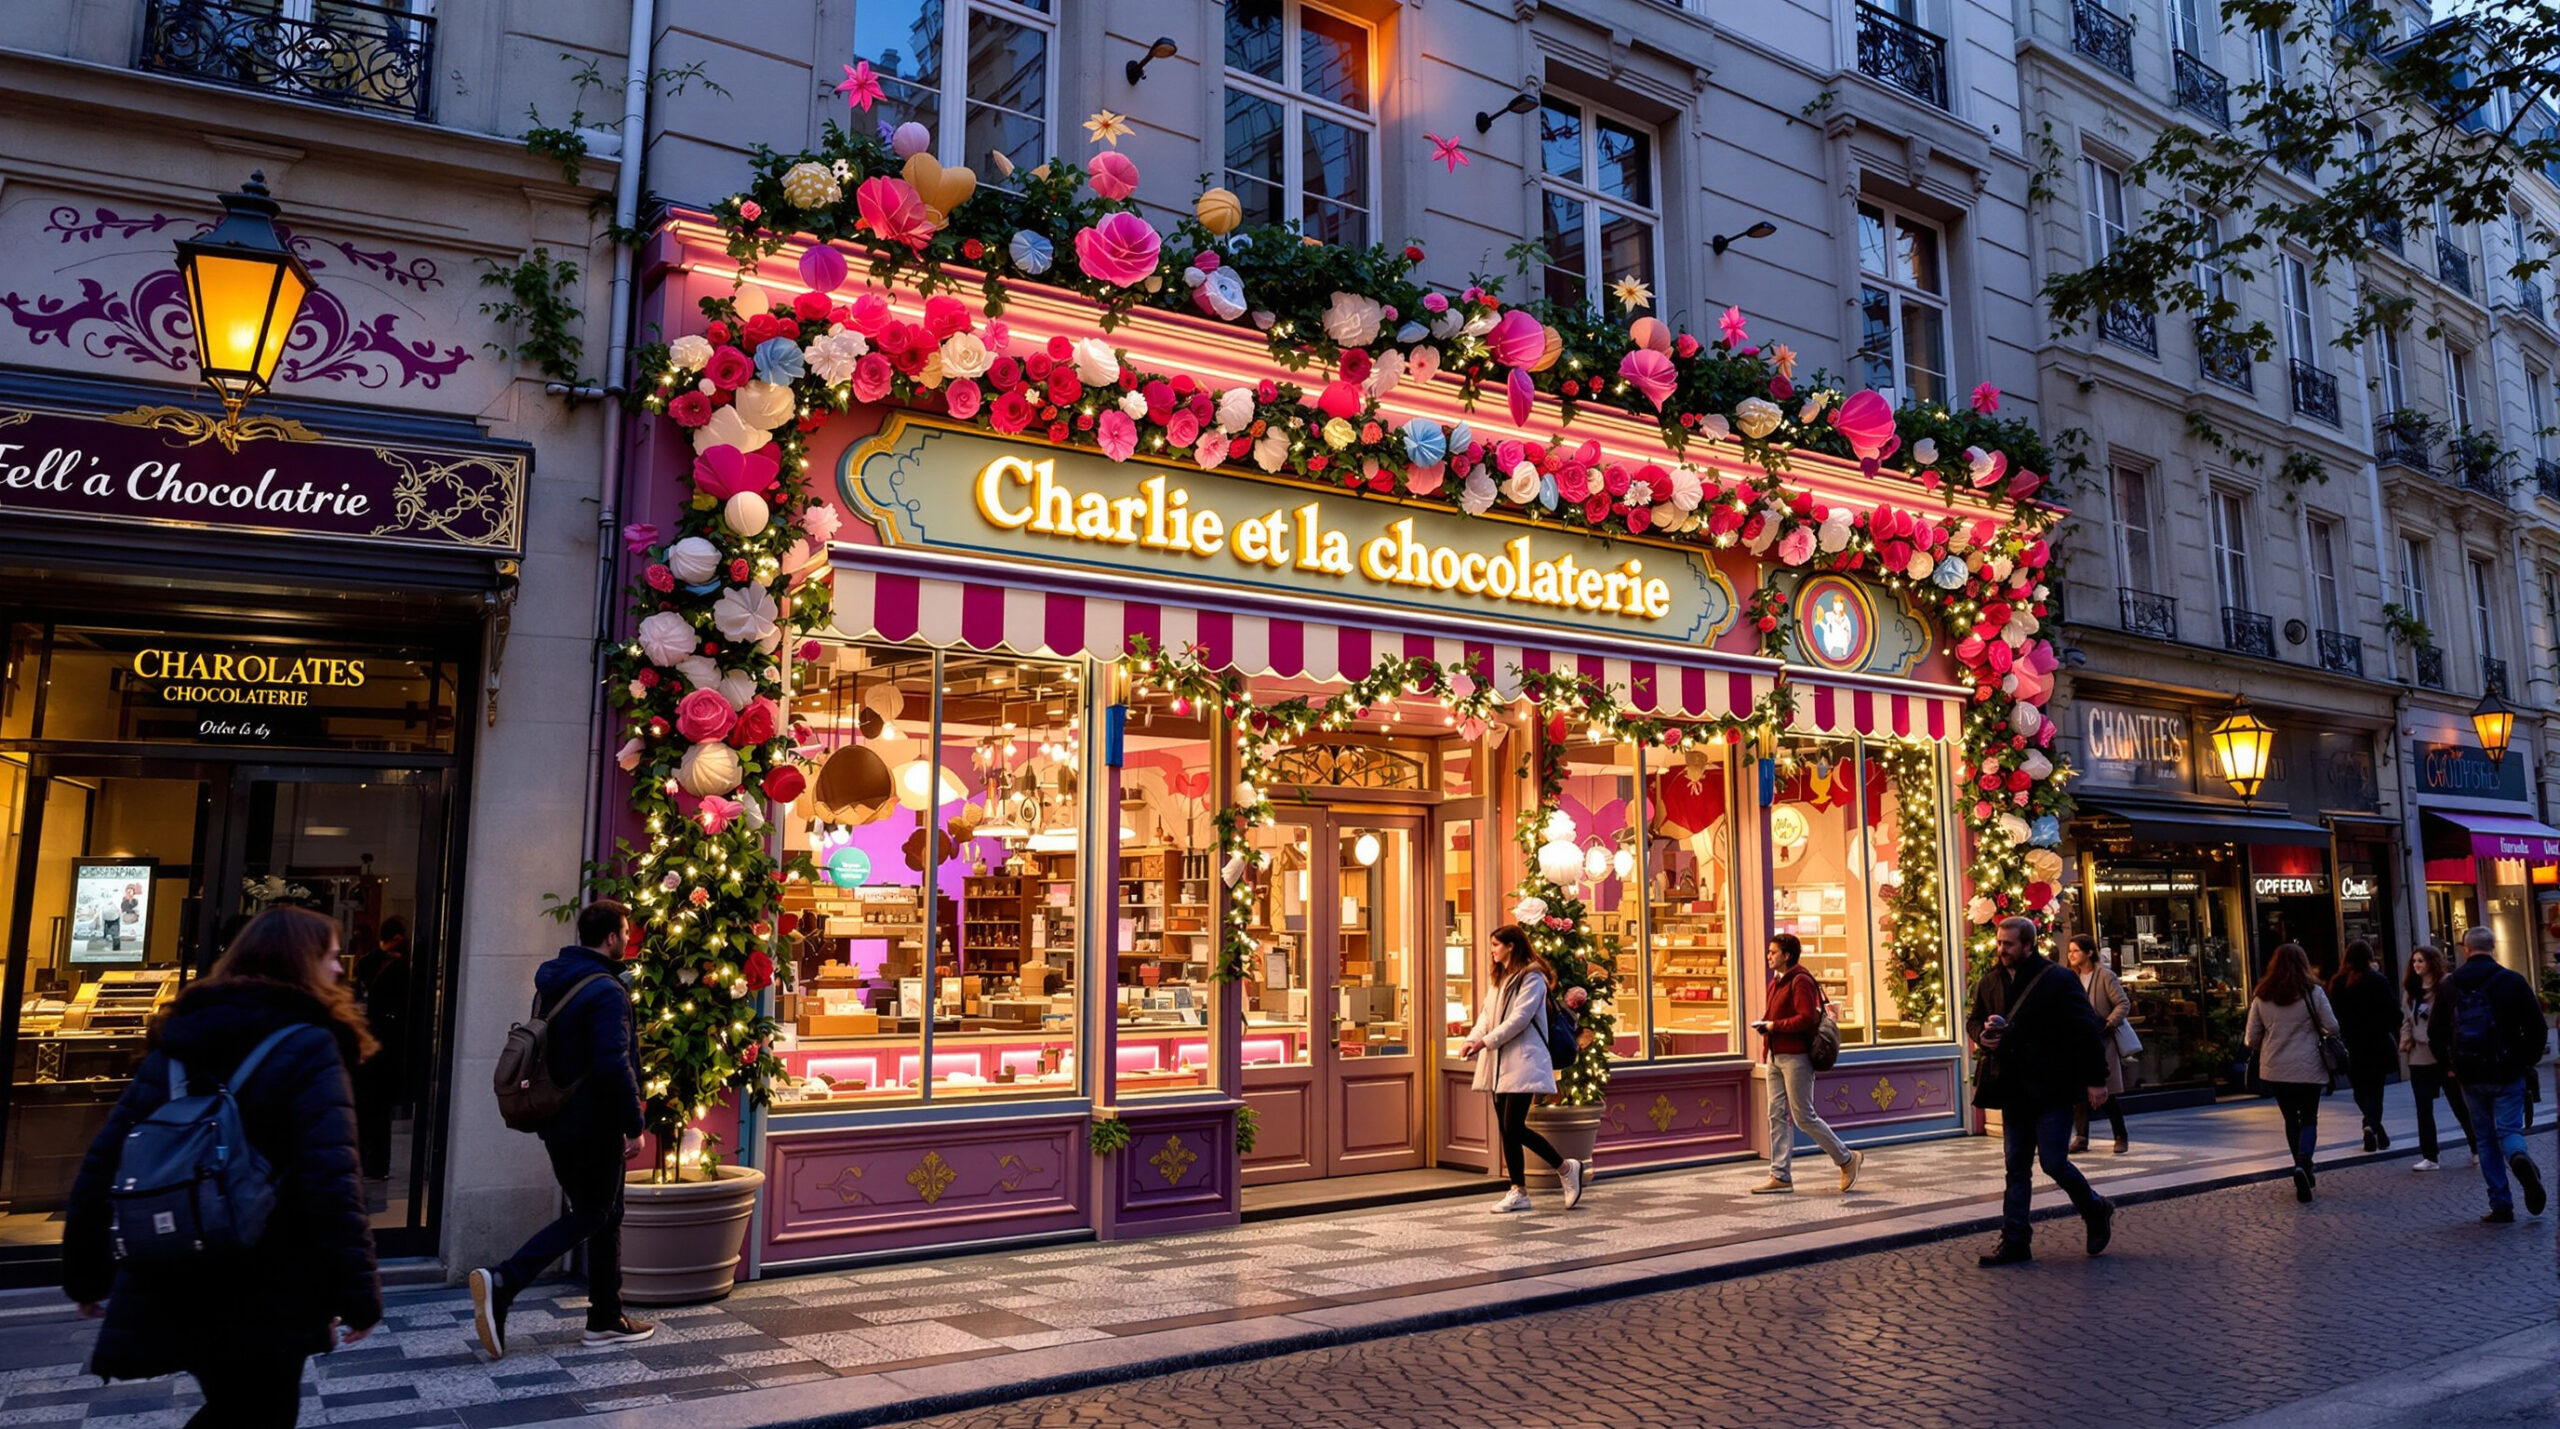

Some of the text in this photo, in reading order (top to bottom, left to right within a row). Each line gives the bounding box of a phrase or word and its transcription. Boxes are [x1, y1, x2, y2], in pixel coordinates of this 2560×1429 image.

[126, 460, 371, 517] Chocolatrie
[975, 455, 1672, 619] Charlie et la chocolaterie
[133, 648, 366, 688] CHAROLATES
[162, 685, 309, 707] CHOCOLATERIE
